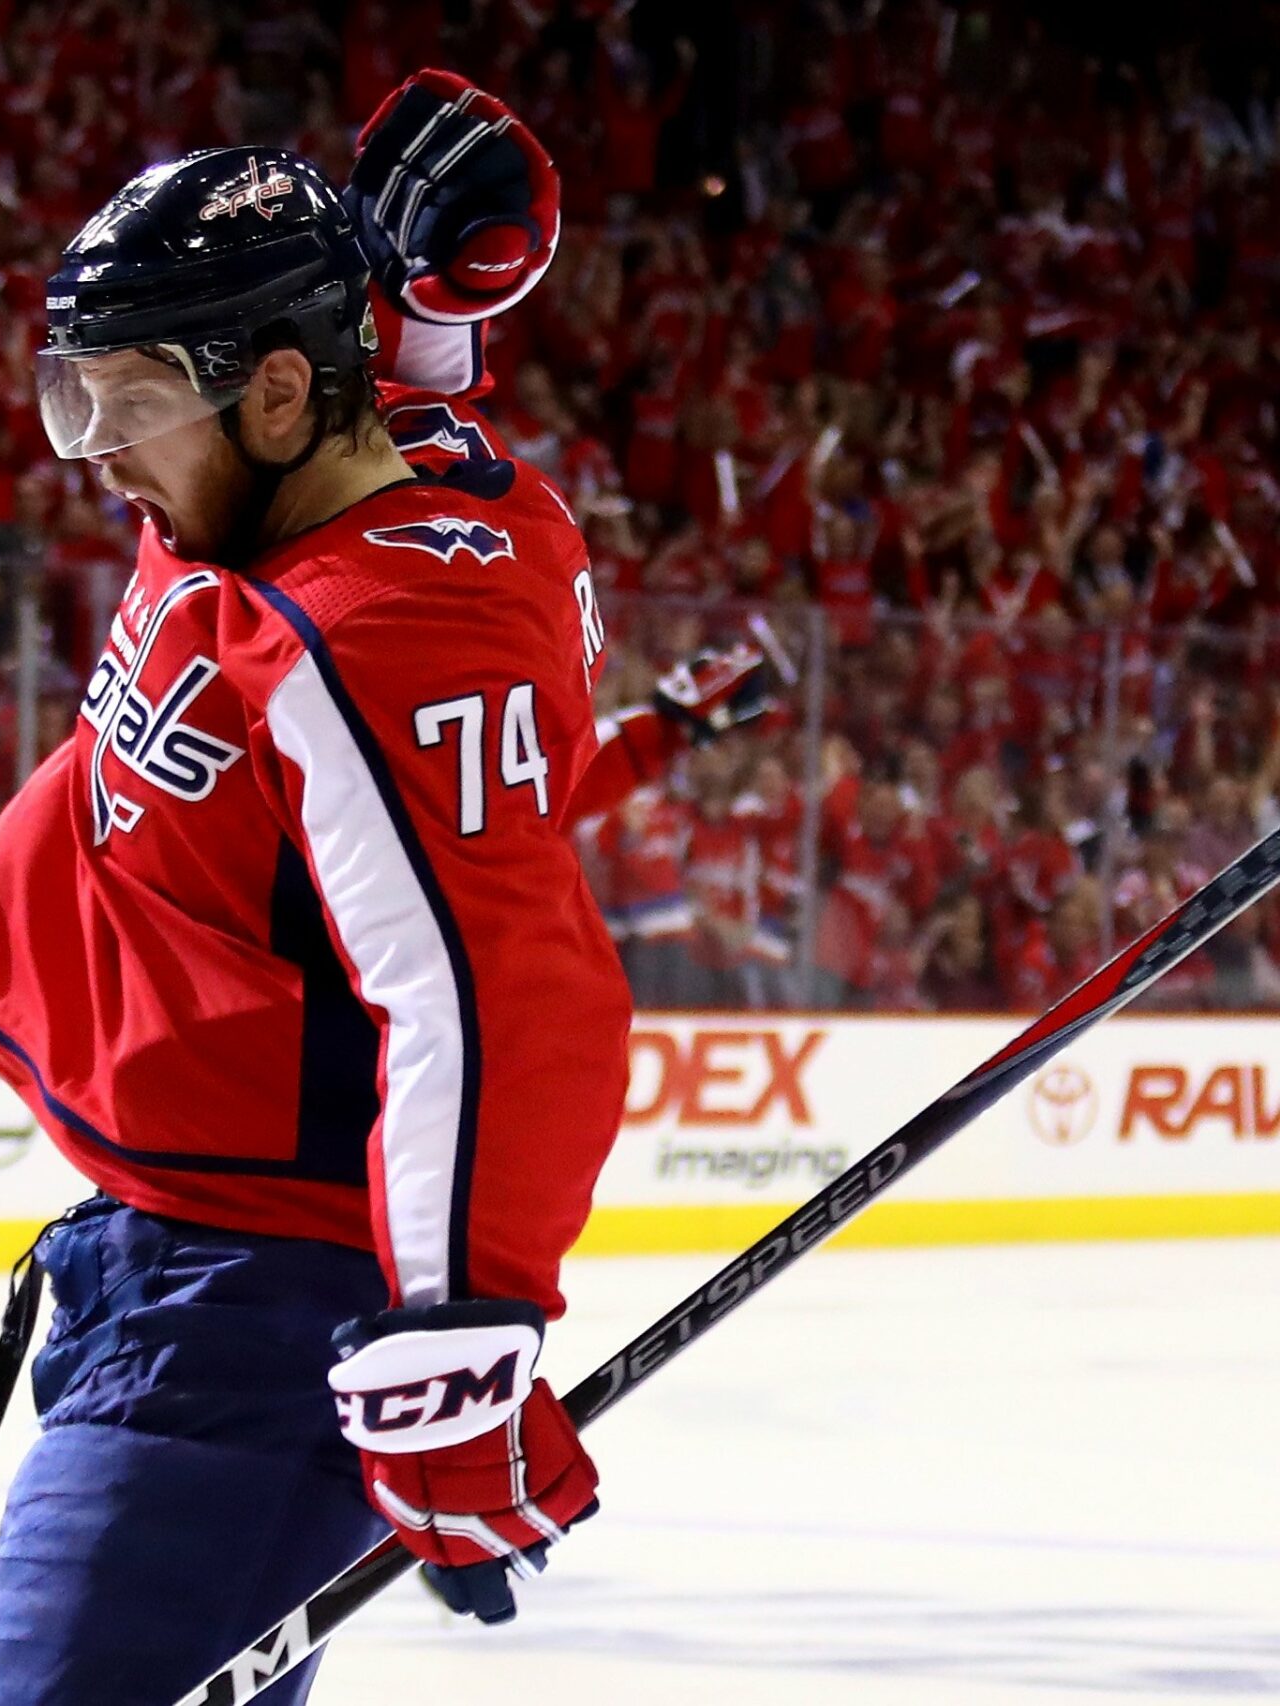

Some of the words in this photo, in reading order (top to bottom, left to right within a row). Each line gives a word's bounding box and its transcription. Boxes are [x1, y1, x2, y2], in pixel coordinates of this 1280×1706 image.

[413, 682, 549, 836] 74
[623, 1030, 829, 1128] DEX
[657, 1136, 849, 1190] imaging
[586, 1142, 908, 1418] JETSPEED
